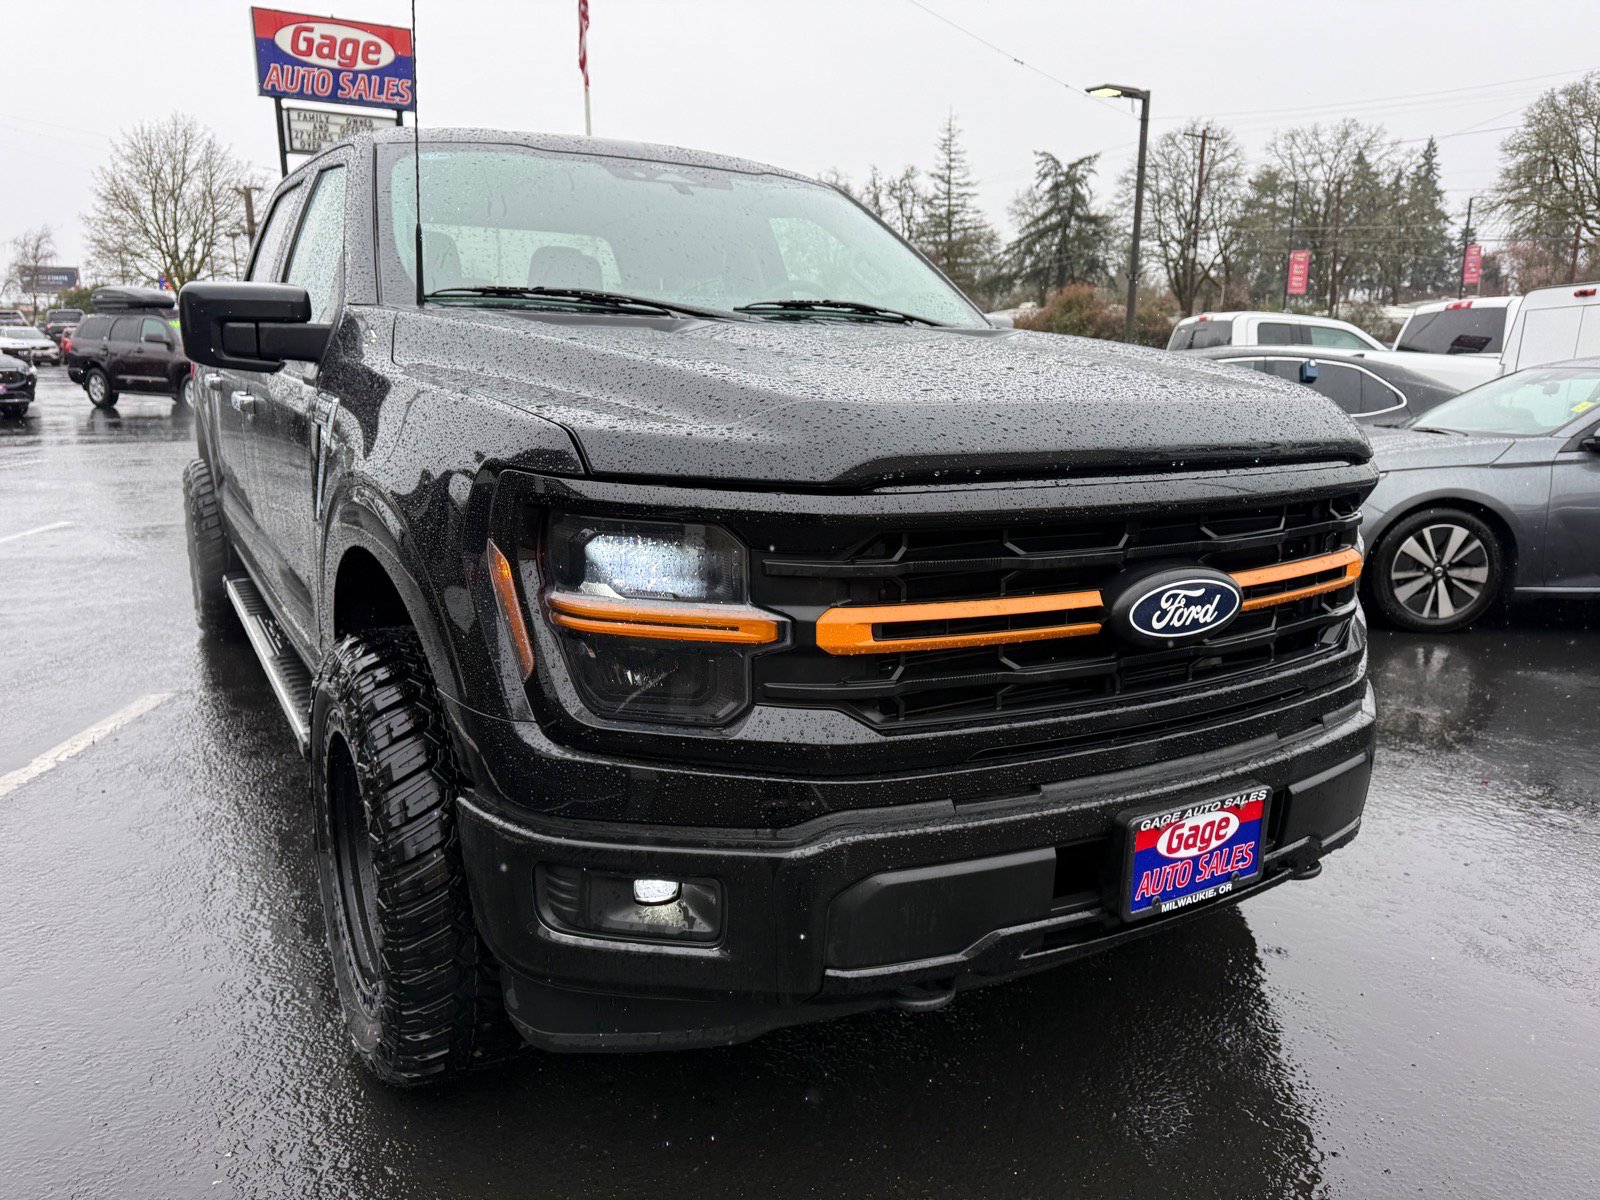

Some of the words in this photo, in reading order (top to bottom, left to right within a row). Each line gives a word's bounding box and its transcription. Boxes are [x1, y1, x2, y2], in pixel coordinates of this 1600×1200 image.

[290, 25, 382, 69] Gage
[263, 63, 333, 97] AUTO
[337, 71, 412, 105] SALES
[297, 112, 330, 123] FAMILY
[1151, 588, 1221, 630] Ford
[1140, 811, 1181, 832] GAGE
[1183, 801, 1221, 820] AUTO
[1223, 790, 1268, 808] SALES
[1166, 817, 1231, 854] Gage
[1135, 859, 1193, 902] AUTO
[1195, 841, 1255, 883] SALES
[1218, 883, 1233, 895] OR
